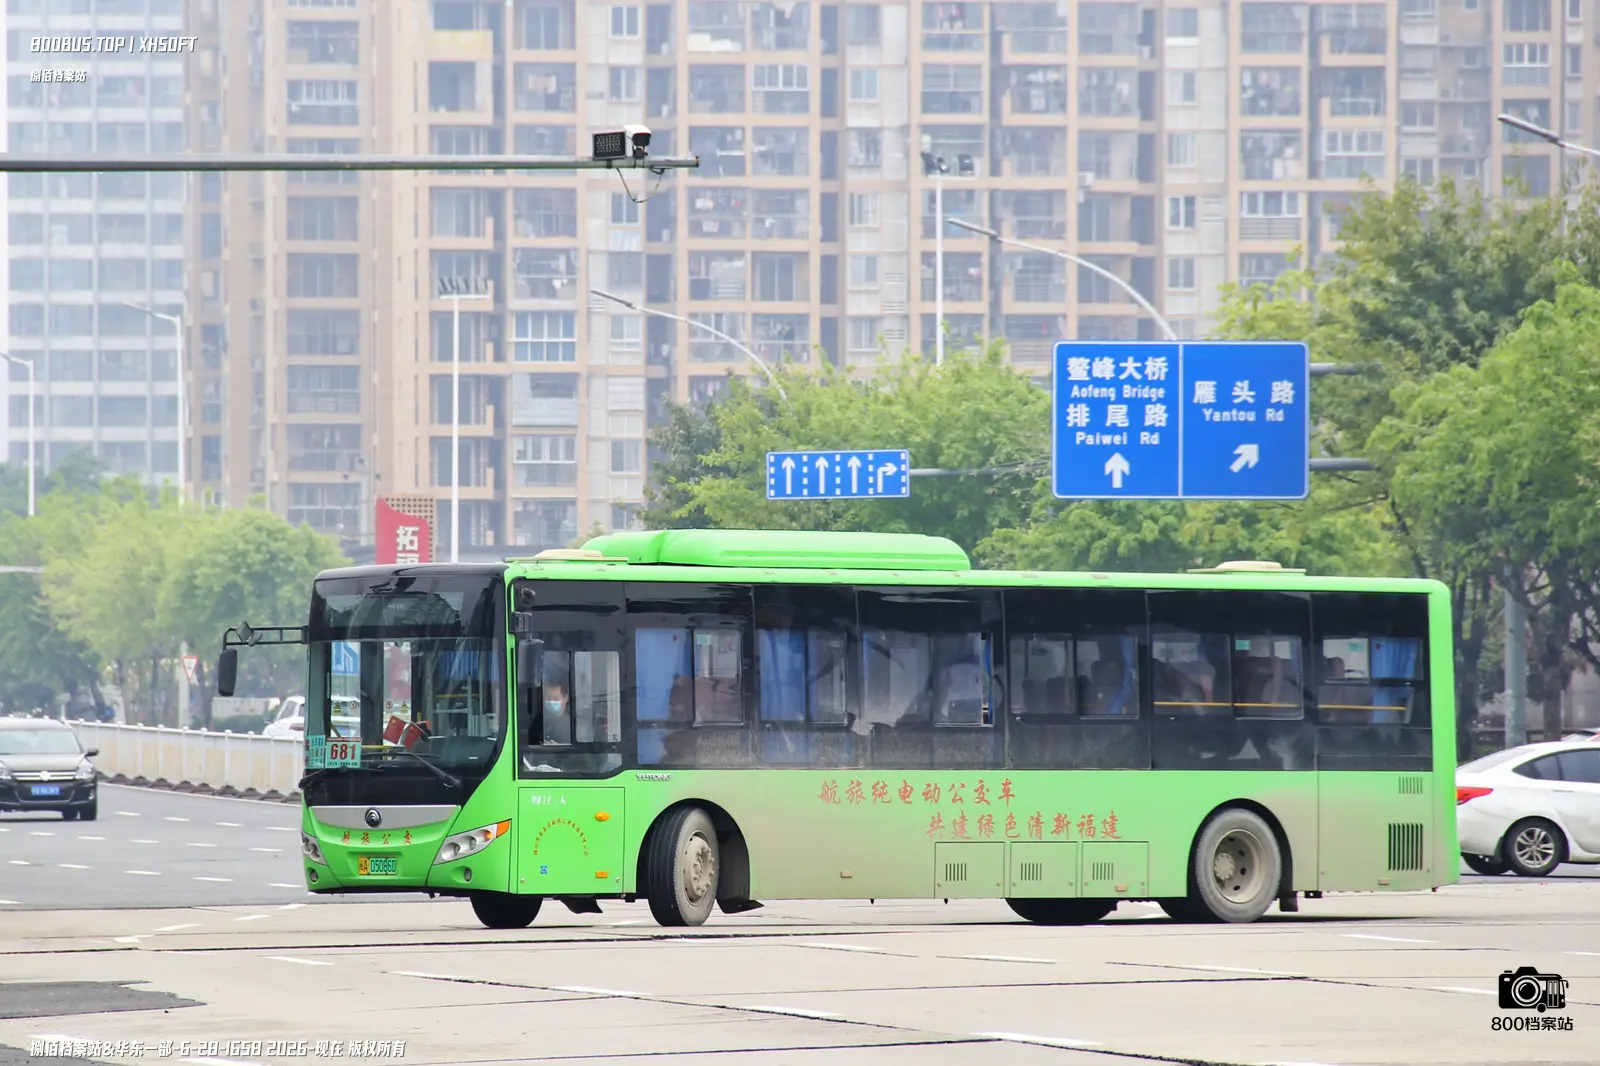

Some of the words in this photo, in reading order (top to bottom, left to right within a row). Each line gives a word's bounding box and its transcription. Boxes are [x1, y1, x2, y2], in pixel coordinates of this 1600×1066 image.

[1066, 356, 1169, 381] 鳌峰大桥
[1070, 384, 1116, 402] Aofeng
[1122, 384, 1165, 402] Bridge
[1192, 380, 1296, 404] 雁头路
[1066, 403, 1169, 428] 排尾路
[1202, 408, 1256, 422] Yantou
[1265, 408, 1284, 422] Rd
[1075, 431, 1128, 445] Paiwei
[1139, 431, 1160, 445] Rd
[330, 743, 356, 760] 681
[636, 772, 672, 781] YUTONG
[817, 777, 1017, 807] 航旅纯电动公交车
[925, 809, 1123, 840] 共建绿色清新福建
